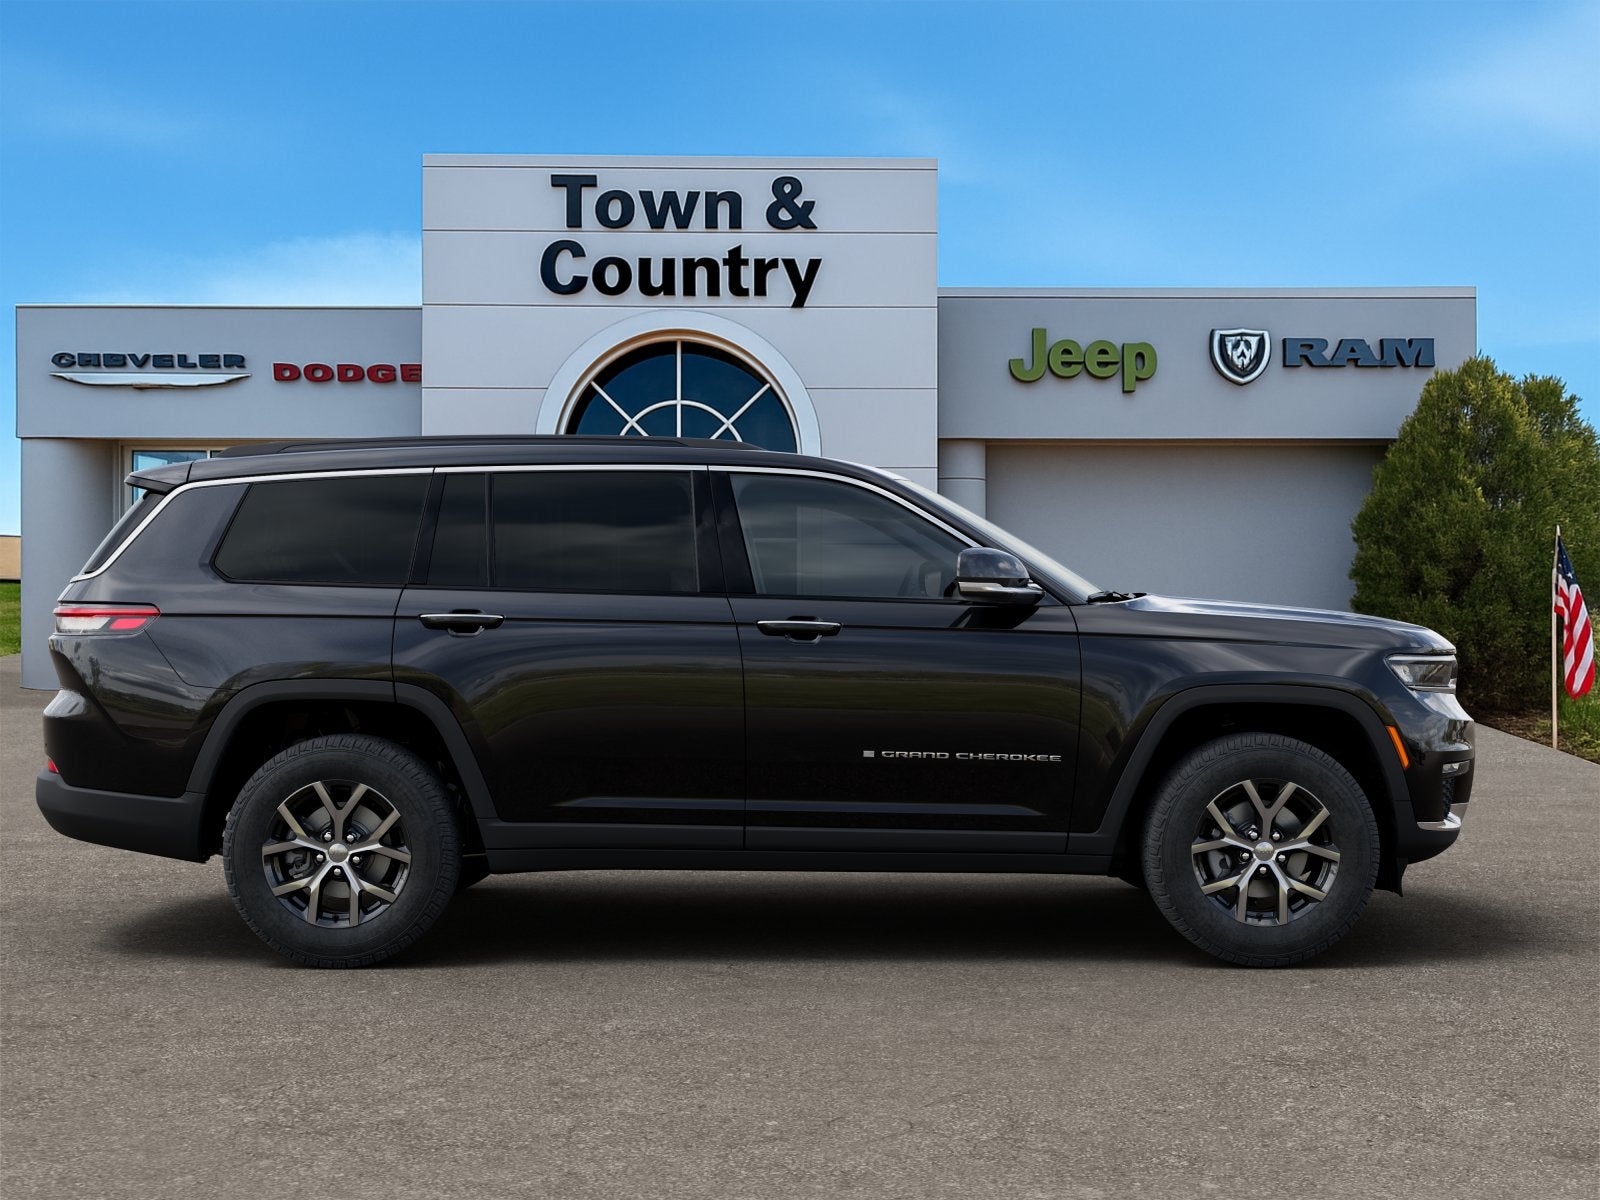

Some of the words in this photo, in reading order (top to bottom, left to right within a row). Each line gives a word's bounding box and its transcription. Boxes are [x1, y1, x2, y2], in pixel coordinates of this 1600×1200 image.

[550, 174, 743, 230] Town
[765, 176, 818, 230] &
[539, 239, 822, 308] Country
[272, 362, 422, 384] DODGE
[1008, 328, 1158, 393] Jeep
[1282, 338, 1435, 368] RAM
[881, 750, 949, 759] GRAND
[955, 752, 1062, 762] CHEROKEE
